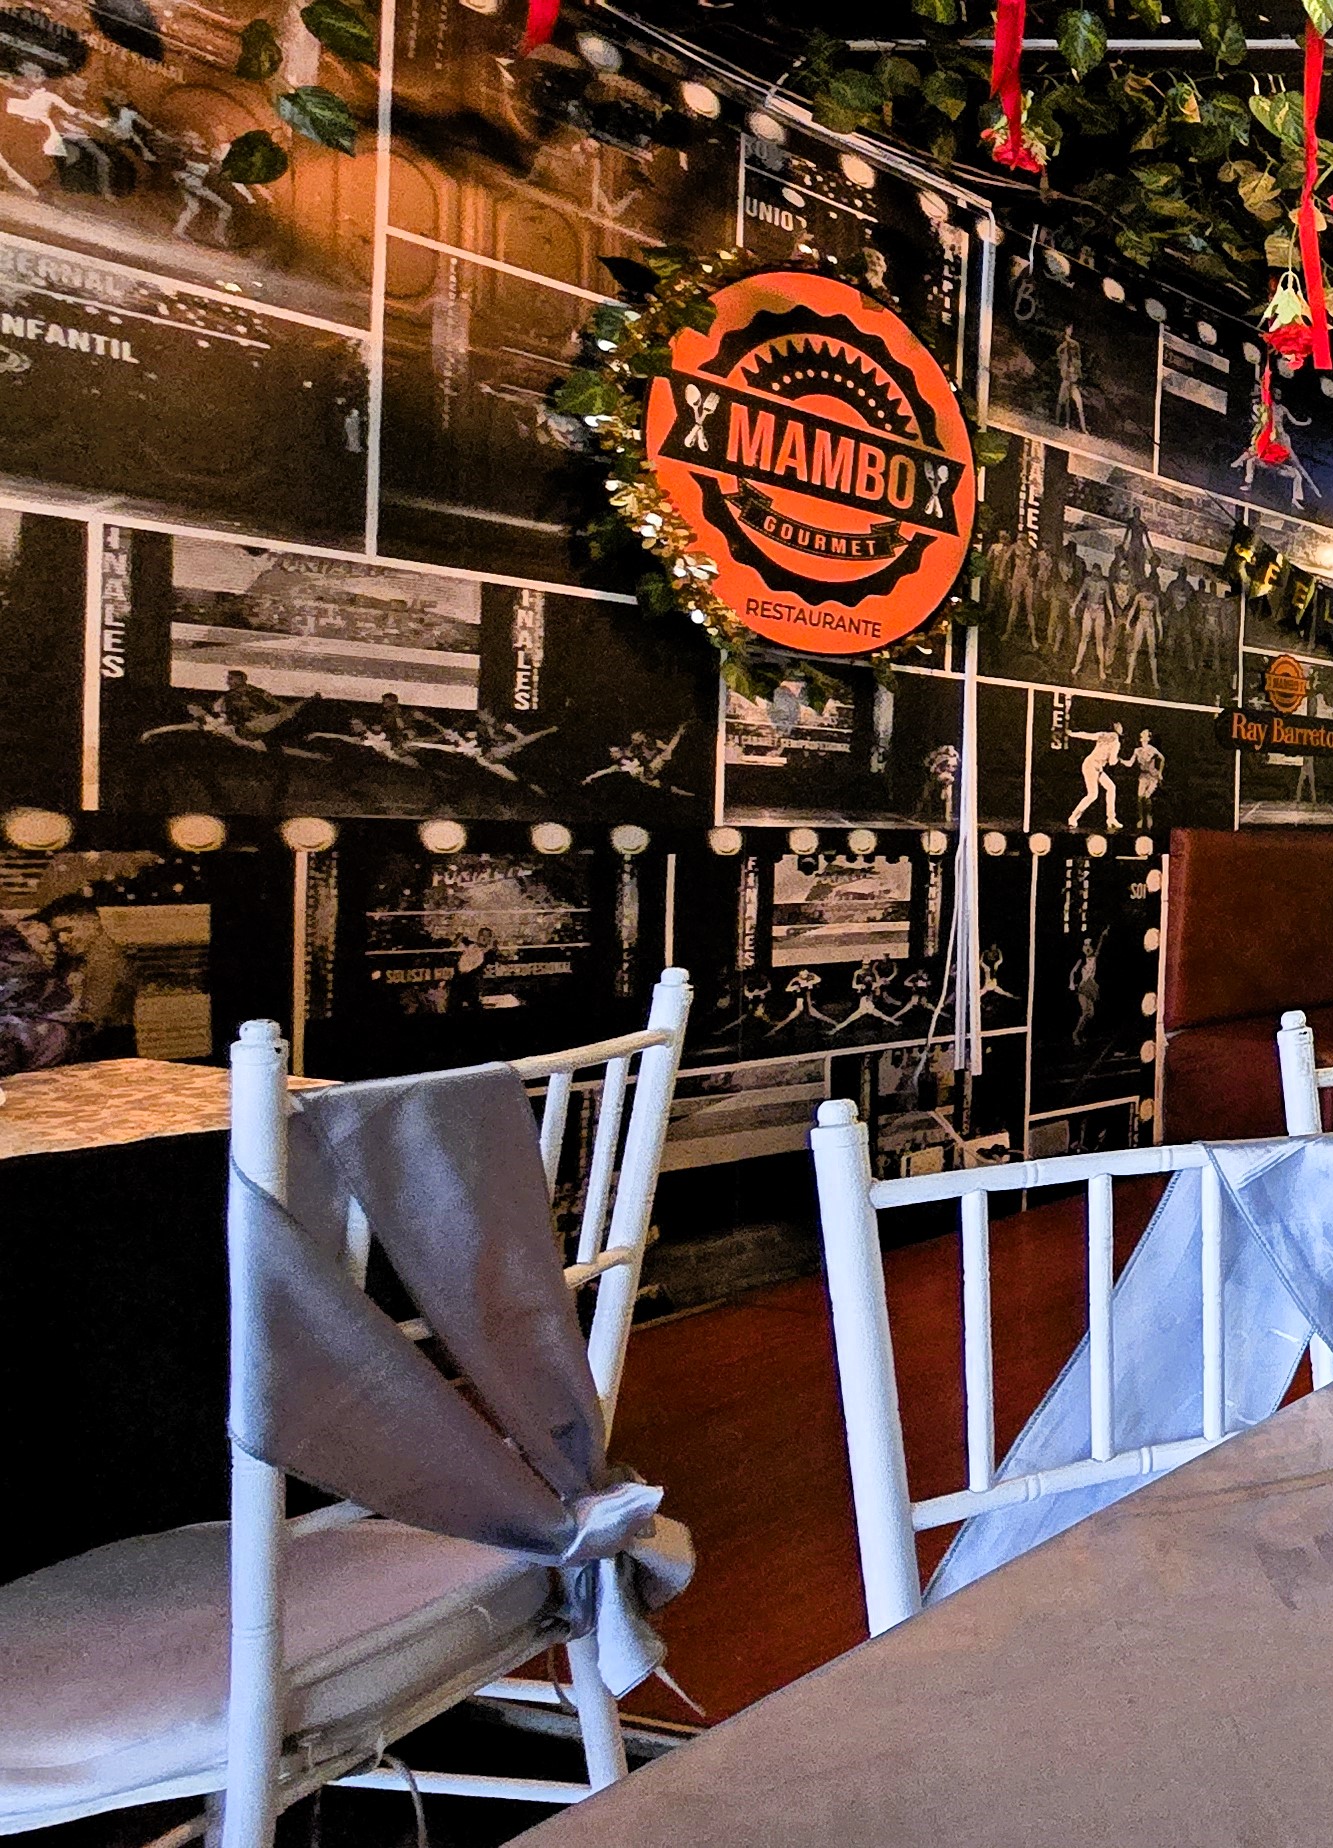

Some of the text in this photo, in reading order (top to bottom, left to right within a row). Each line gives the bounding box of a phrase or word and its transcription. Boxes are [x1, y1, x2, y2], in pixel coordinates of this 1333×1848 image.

[726, 401, 917, 511] MAMBO
[763, 514, 877, 556] GOURMET
[745, 597, 883, 640] RESTAURANTE
[1231, 712, 1269, 751] Ray
